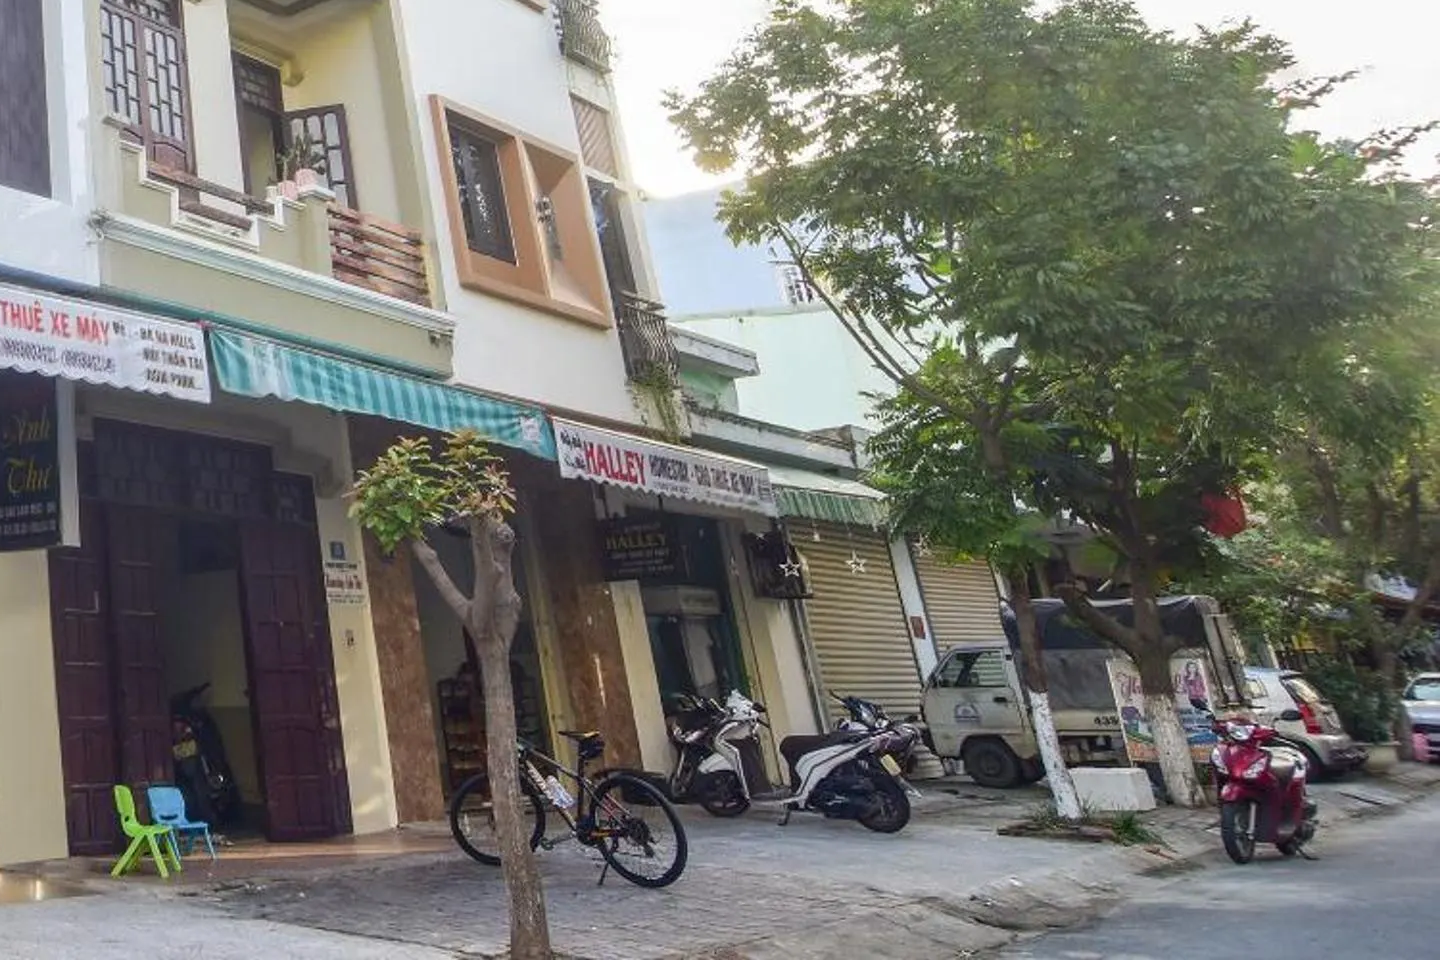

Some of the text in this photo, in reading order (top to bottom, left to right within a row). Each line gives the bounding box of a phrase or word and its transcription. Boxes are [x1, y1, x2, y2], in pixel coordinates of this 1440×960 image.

[50, 310, 73, 338] XE
[76, 311, 111, 346] MÁY
[584, 440, 646, 486] HALLEY
